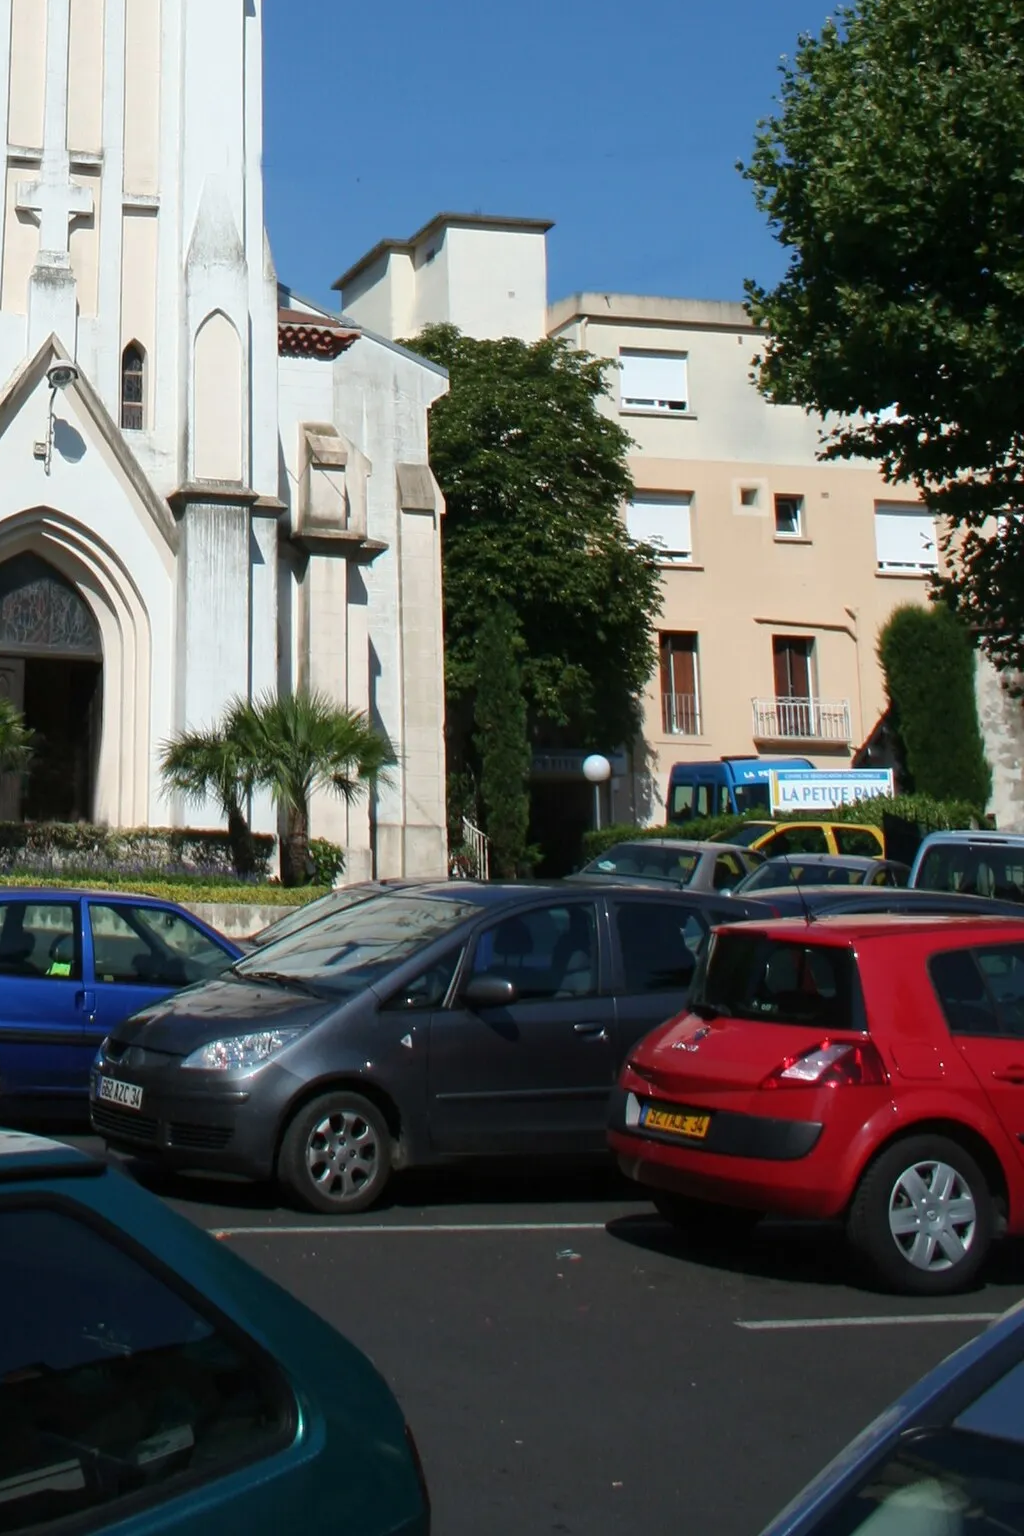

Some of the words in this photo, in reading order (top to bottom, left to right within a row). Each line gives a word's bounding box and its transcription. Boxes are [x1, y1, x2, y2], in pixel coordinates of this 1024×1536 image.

[782, 786, 799, 801] LA
[802, 786, 849, 802] PETITE
[130, 1087, 141, 1108] 34
